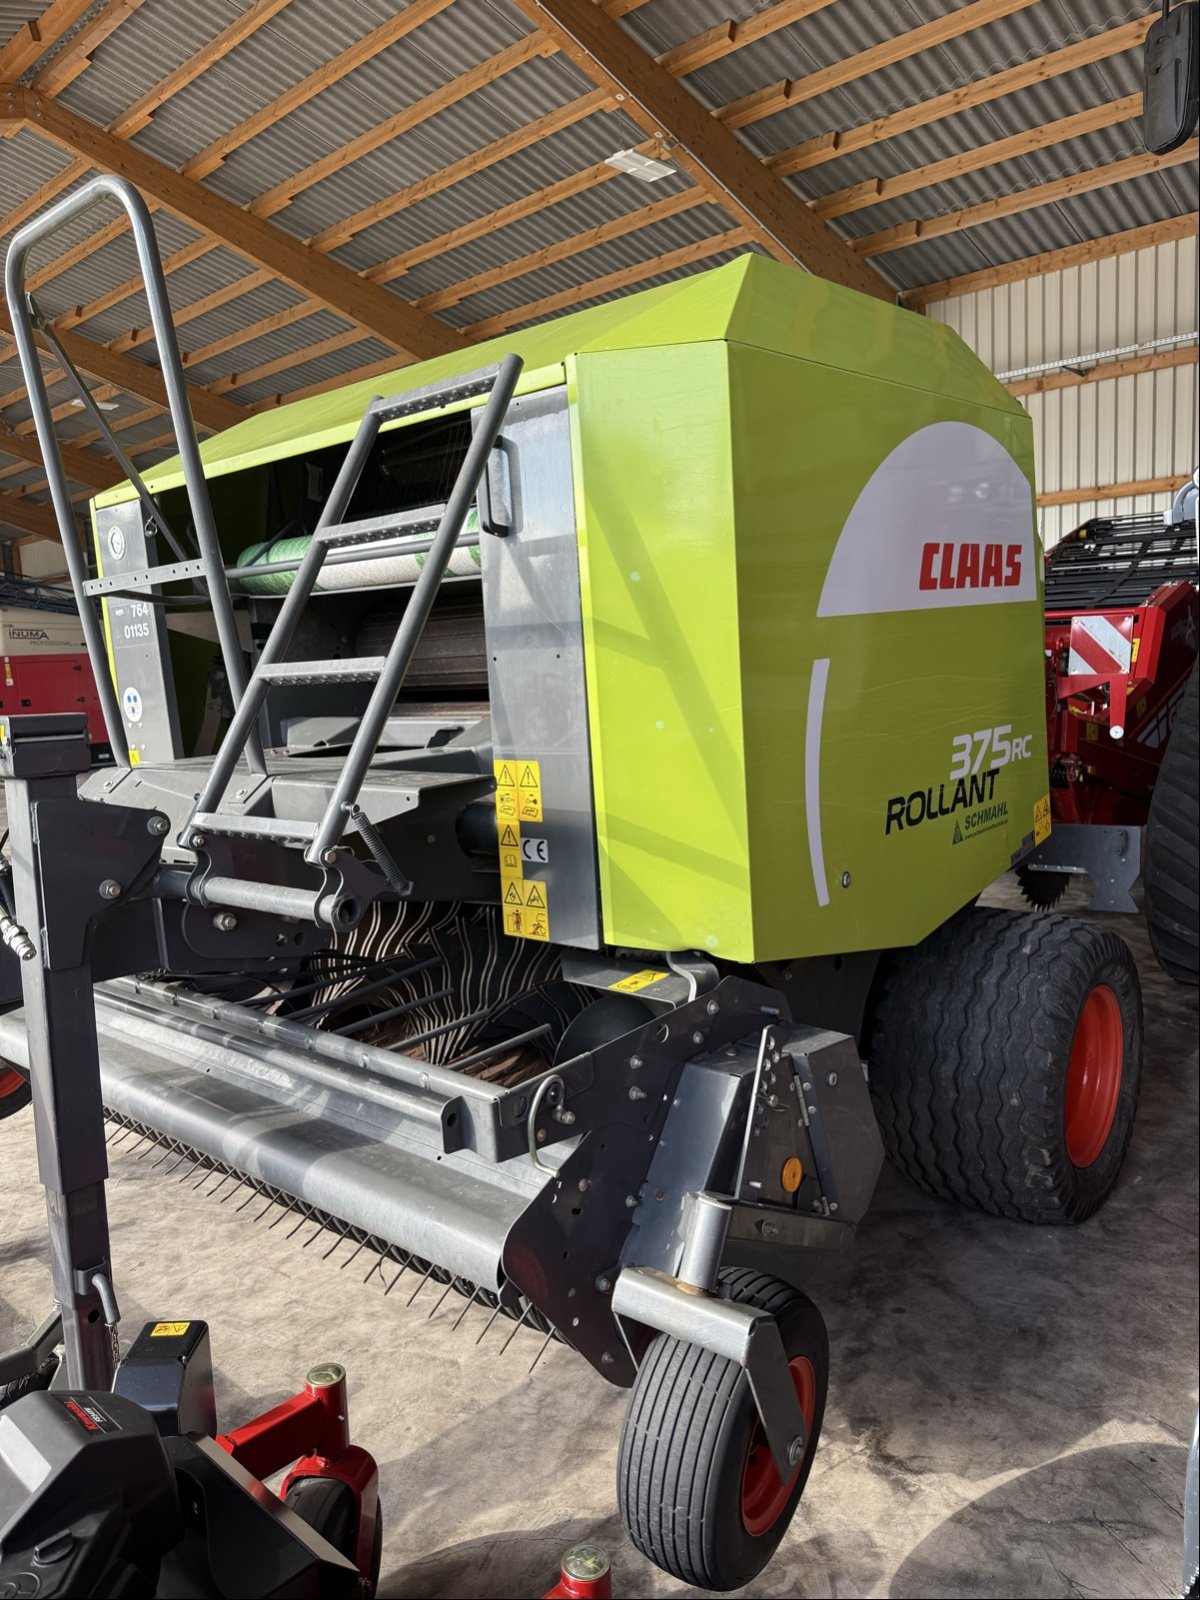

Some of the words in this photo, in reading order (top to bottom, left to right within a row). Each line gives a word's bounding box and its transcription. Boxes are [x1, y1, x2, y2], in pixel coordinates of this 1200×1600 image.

[919, 542, 1023, 591] CLAAS
[131, 602, 149, 618] 764
[8, 628, 50, 641] INUMA
[124, 622, 150, 639] 01135
[885, 768, 1001, 836] ROLLANT
[964, 800, 1009, 831] SCHMAHL
